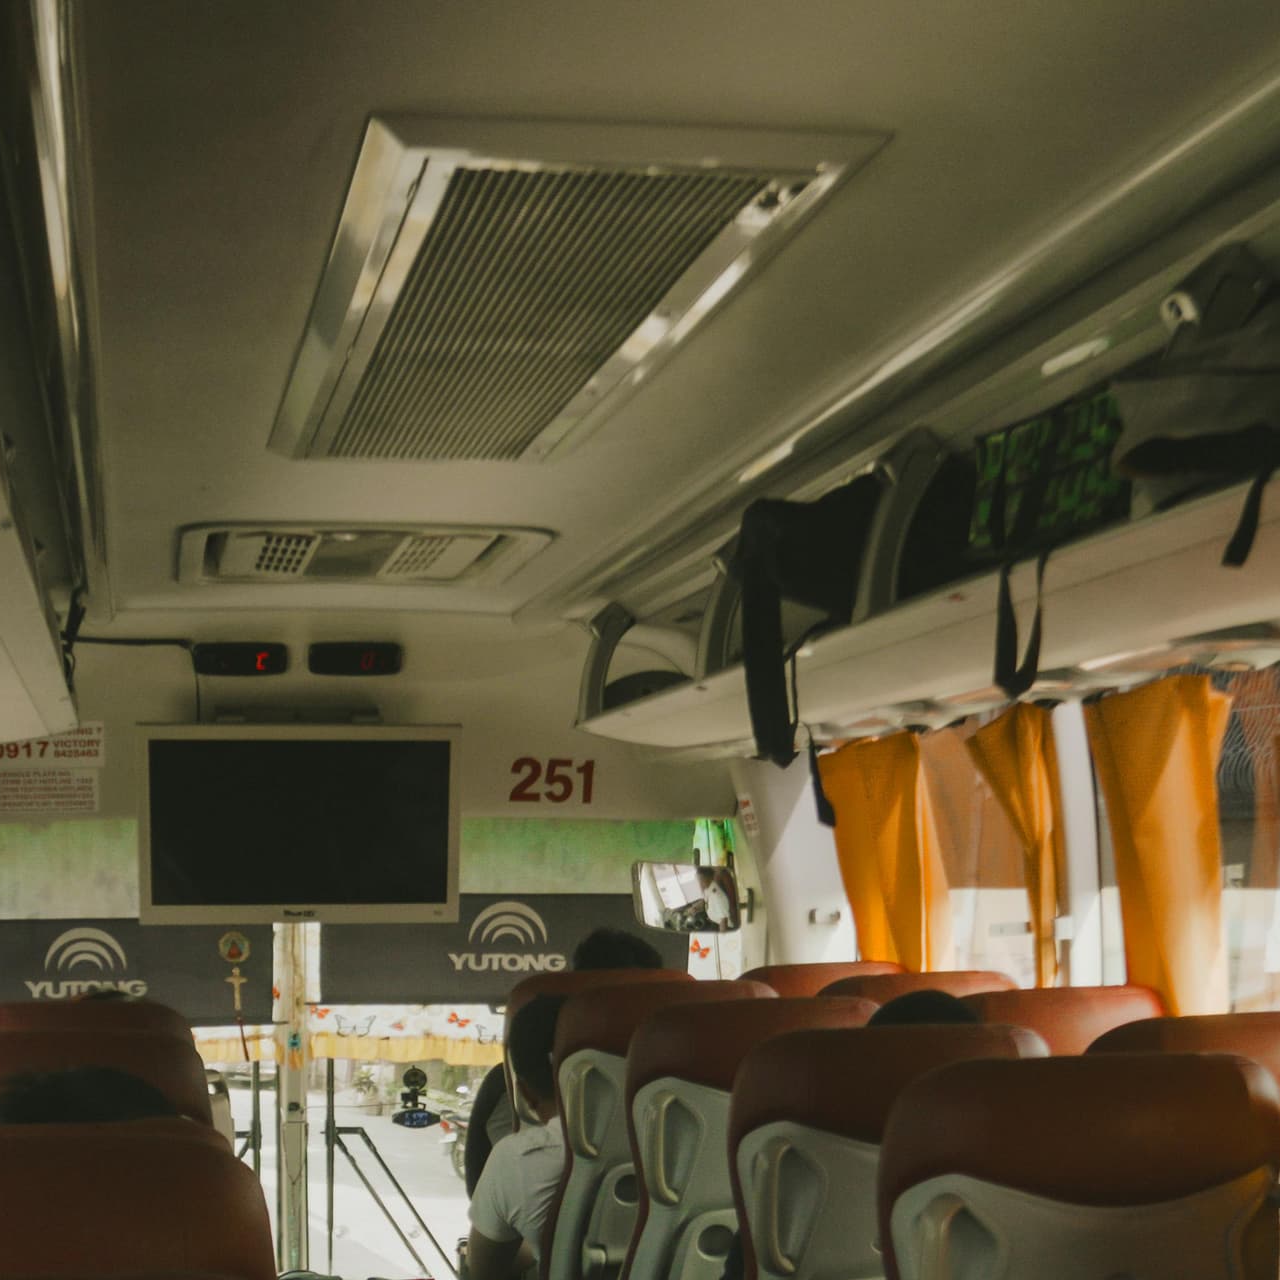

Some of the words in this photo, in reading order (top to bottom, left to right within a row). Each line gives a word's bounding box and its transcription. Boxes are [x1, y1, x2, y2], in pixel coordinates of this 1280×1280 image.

[53, 740, 99, 748] VICTORY
[509, 757, 595, 804] 251
[448, 954, 566, 972] YUTONG
